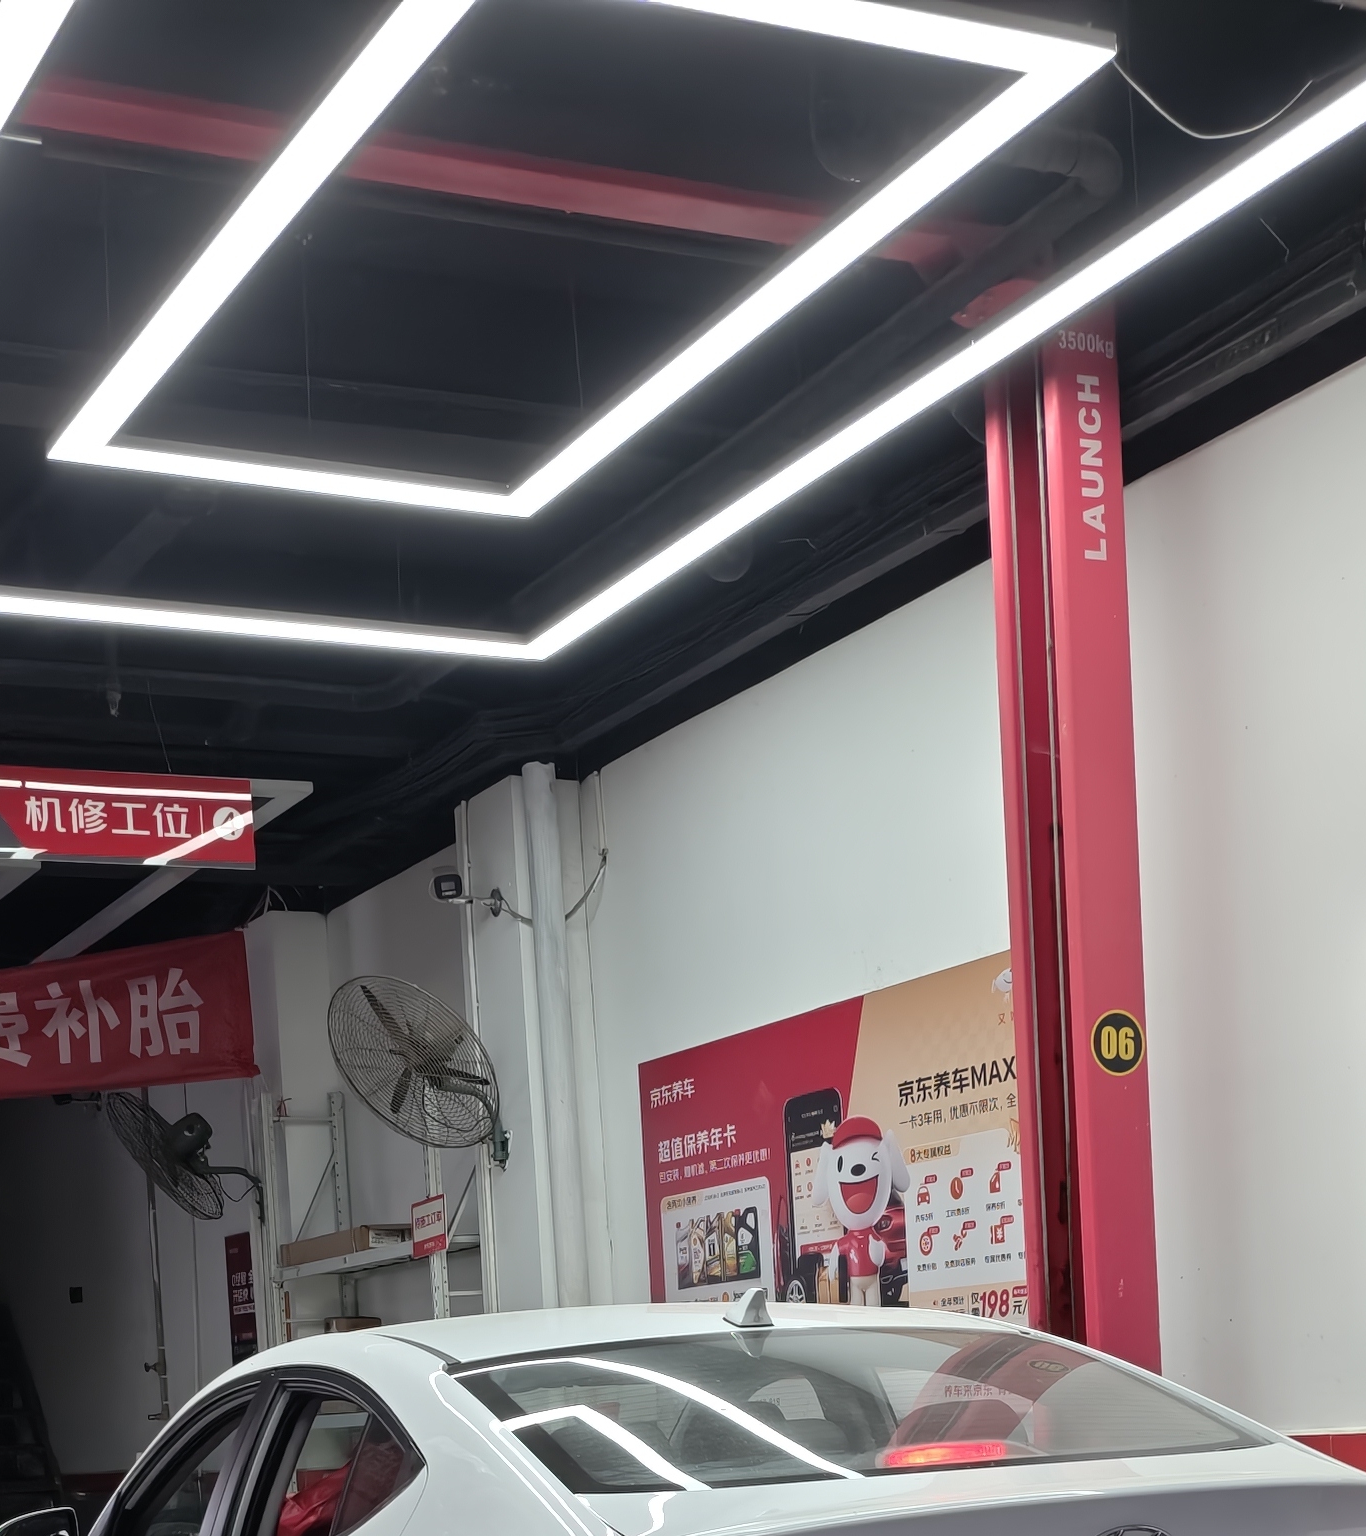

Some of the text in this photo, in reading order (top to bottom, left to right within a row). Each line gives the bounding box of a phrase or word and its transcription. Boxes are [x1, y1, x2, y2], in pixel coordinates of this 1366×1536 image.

[1058, 330, 1114, 359] 3500kg
[1076, 374, 1107, 562] LAUNCH
[24, 796, 192, 839] 机修工位
[1100, 1025, 1135, 1061] 06
[649, 1078, 696, 1109] 京东养车
[897, 1056, 1017, 1108] 京东养车MAX
[657, 1123, 737, 1164] 超值保养年卡
[980, 1287, 1010, 1319] 198
